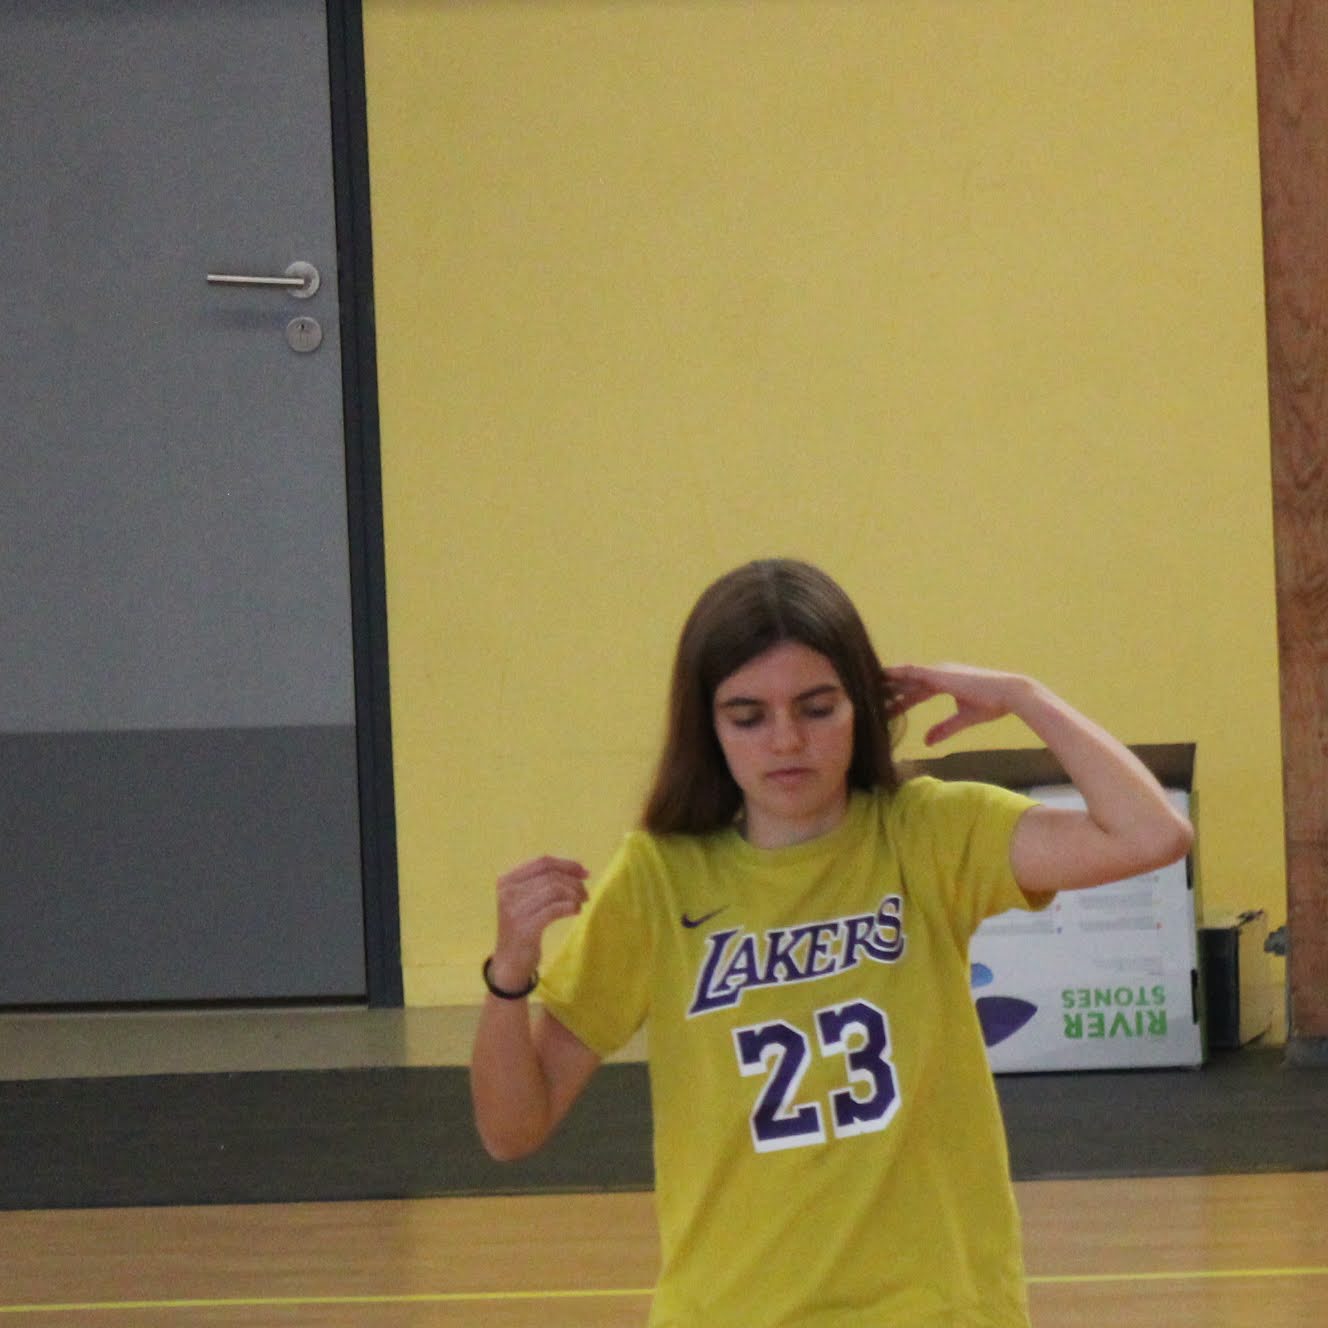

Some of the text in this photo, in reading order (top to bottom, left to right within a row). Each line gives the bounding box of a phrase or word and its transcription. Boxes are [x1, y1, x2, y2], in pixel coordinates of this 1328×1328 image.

[686, 894, 906, 1020] LAKERS
[1061, 984, 1167, 1009] STONES
[1062, 1011, 1169, 1040] RIVER
[731, 998, 902, 1153] 23
